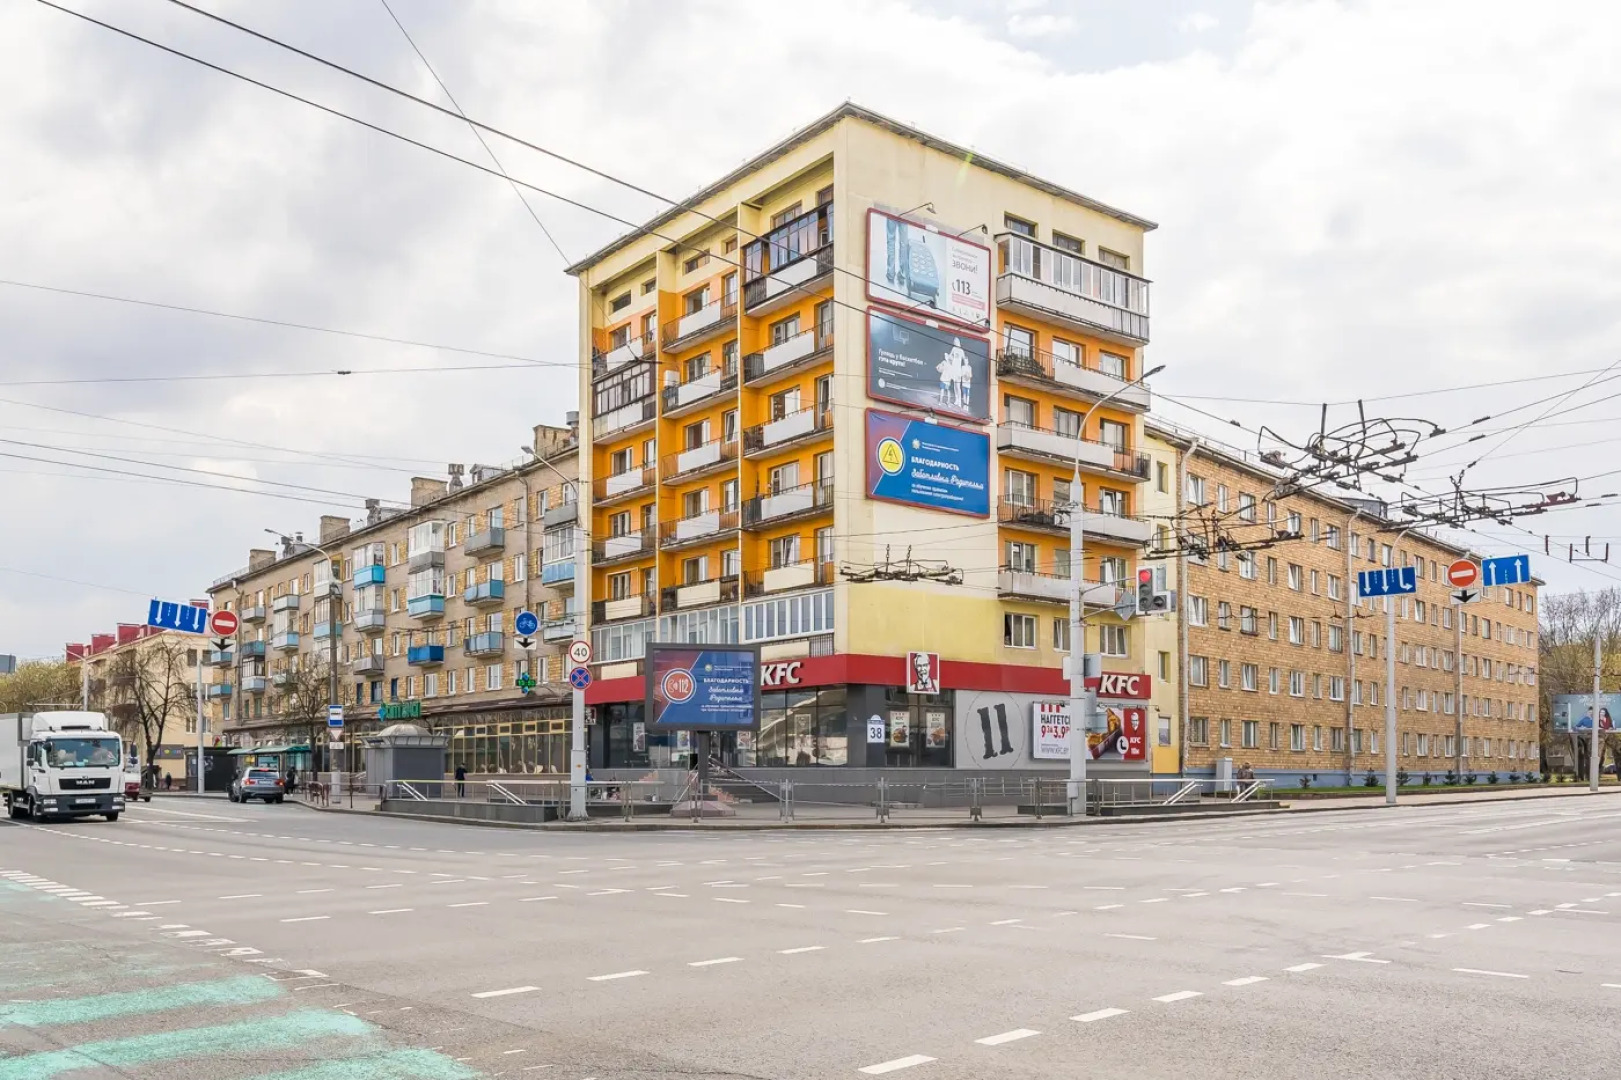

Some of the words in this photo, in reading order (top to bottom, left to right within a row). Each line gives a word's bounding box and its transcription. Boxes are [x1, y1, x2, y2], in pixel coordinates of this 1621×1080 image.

[956, 279, 970, 295] 113
[911, 456, 959, 471] БЛАГОДАРНОСТЬ
[573, 647, 587, 657] 40
[760, 661, 801, 686] KFC
[1099, 674, 1140, 696] KFC
[1041, 714, 1070, 724] НАГГЕТС
[870, 727, 882, 739] 38
